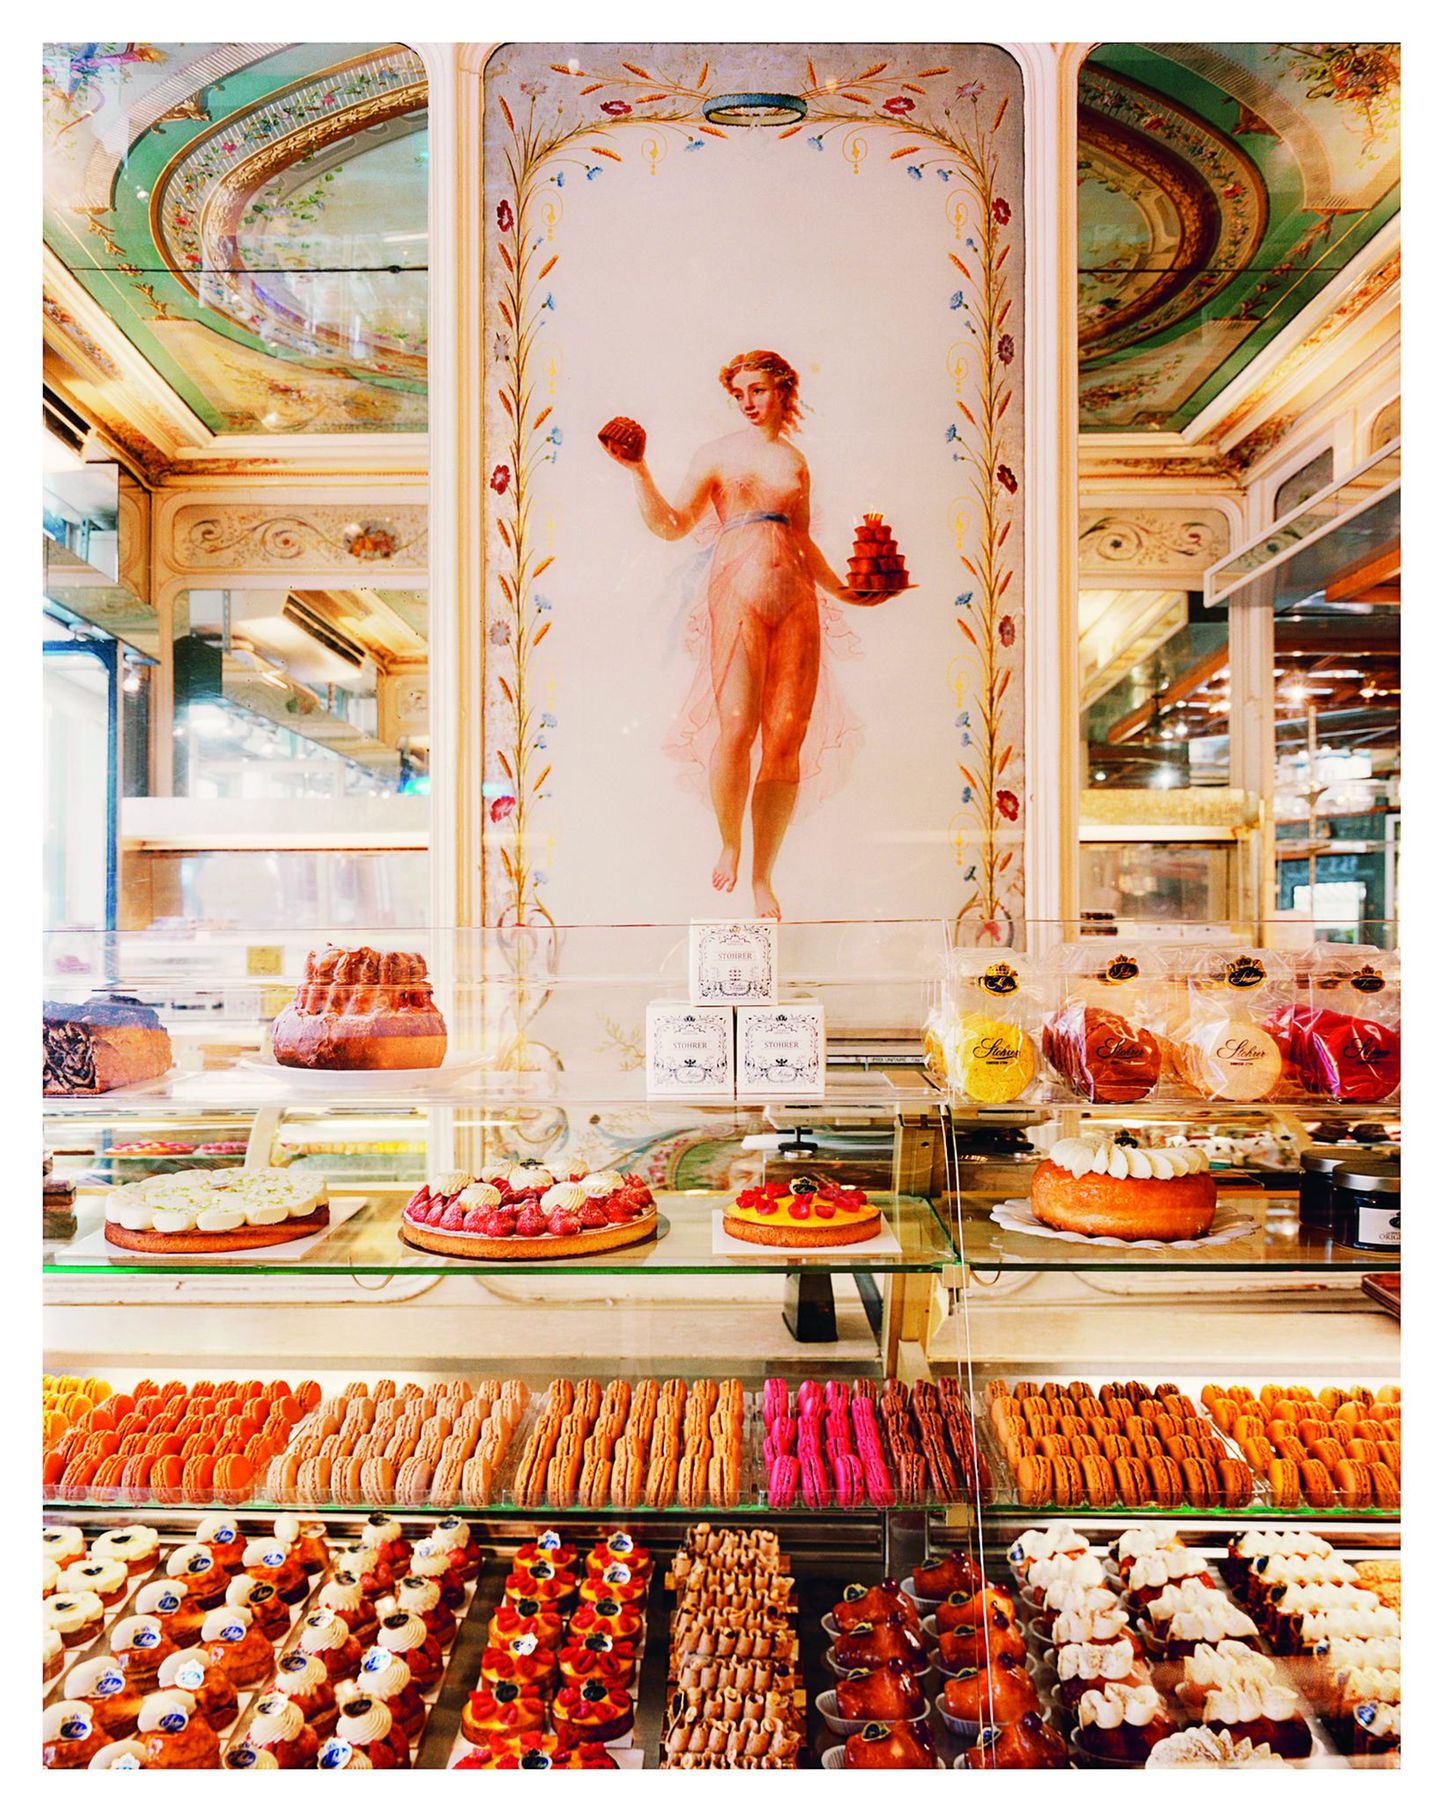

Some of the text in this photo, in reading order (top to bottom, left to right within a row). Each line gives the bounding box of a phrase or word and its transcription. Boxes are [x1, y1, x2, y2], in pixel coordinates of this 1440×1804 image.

[718, 952, 753, 960] STOHRER
[673, 1041, 708, 1049] STOHRER
[764, 1041, 799, 1049] STOHRER
[1216, 1038, 1266, 1061] Stohrer
